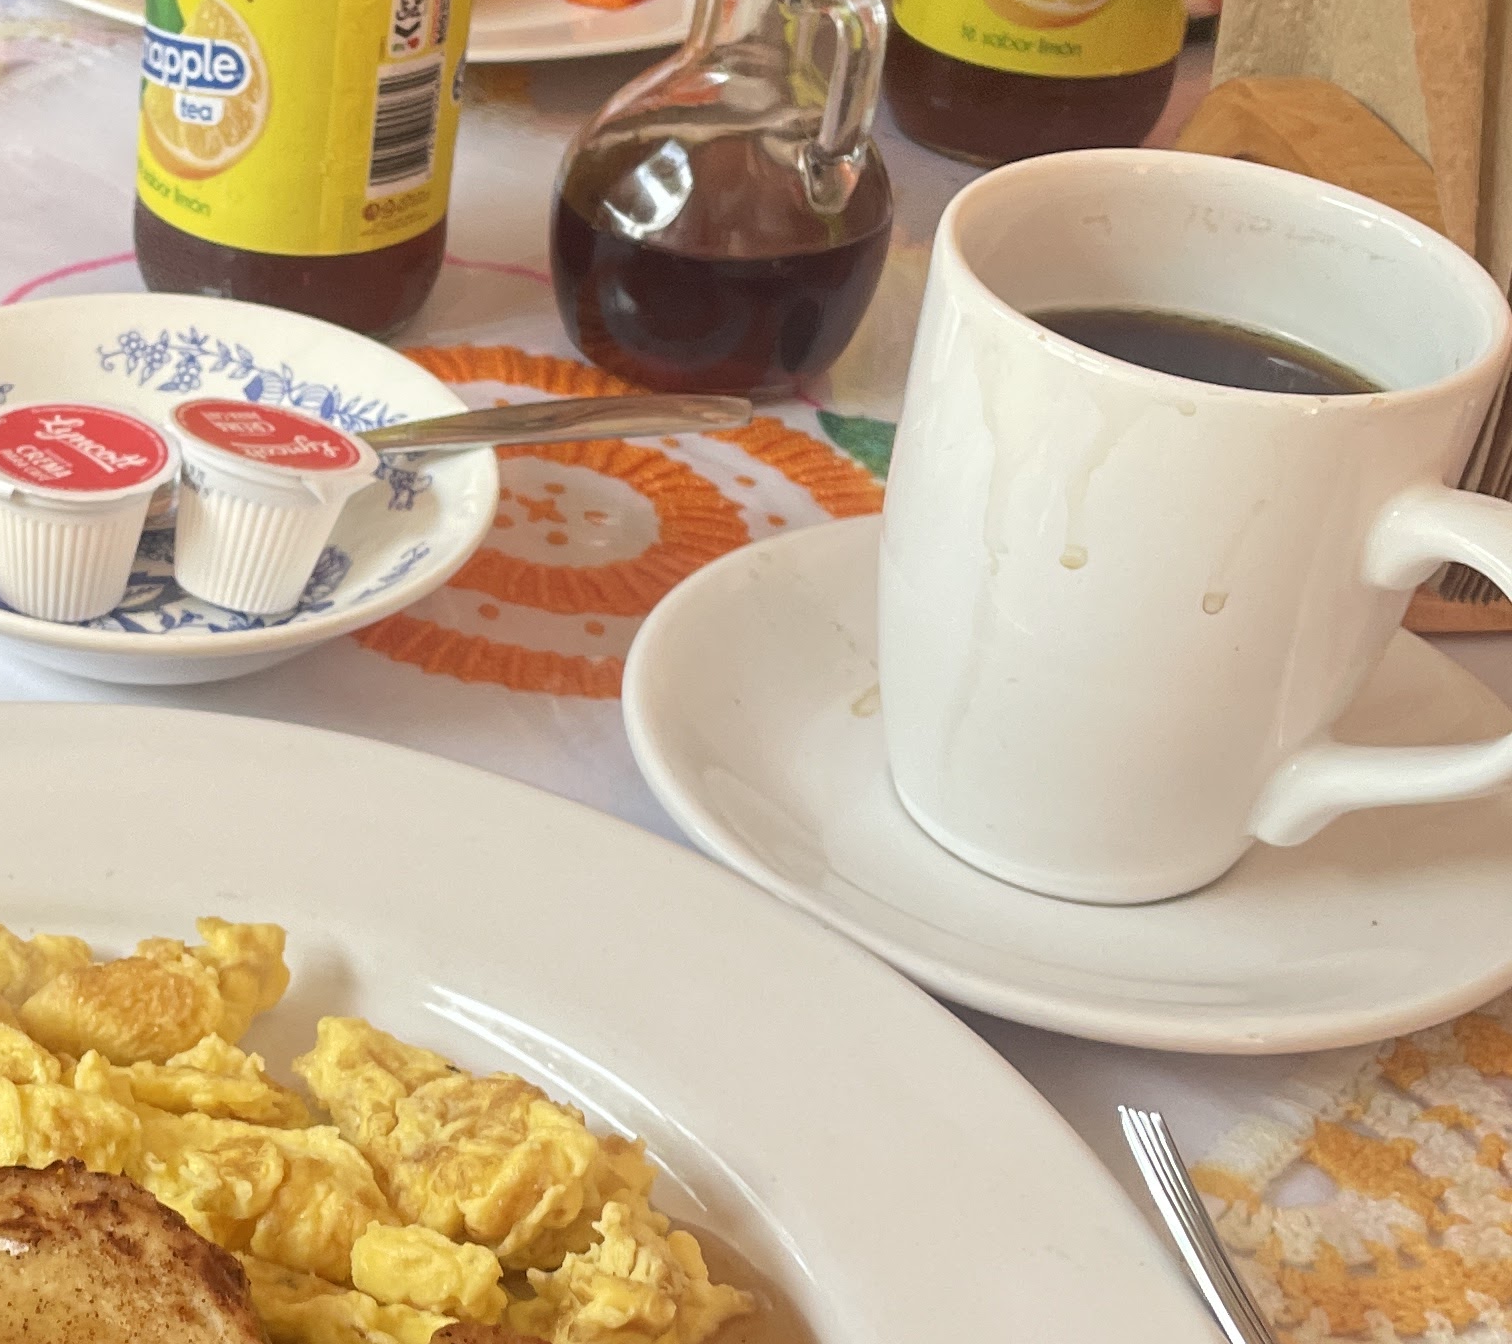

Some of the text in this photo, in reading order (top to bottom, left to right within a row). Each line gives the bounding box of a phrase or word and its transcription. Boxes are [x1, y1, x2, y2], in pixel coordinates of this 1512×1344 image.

[982, 31, 1032, 53] sabor
[143, 35, 239, 92] apple
[180, 97, 214, 122] tea
